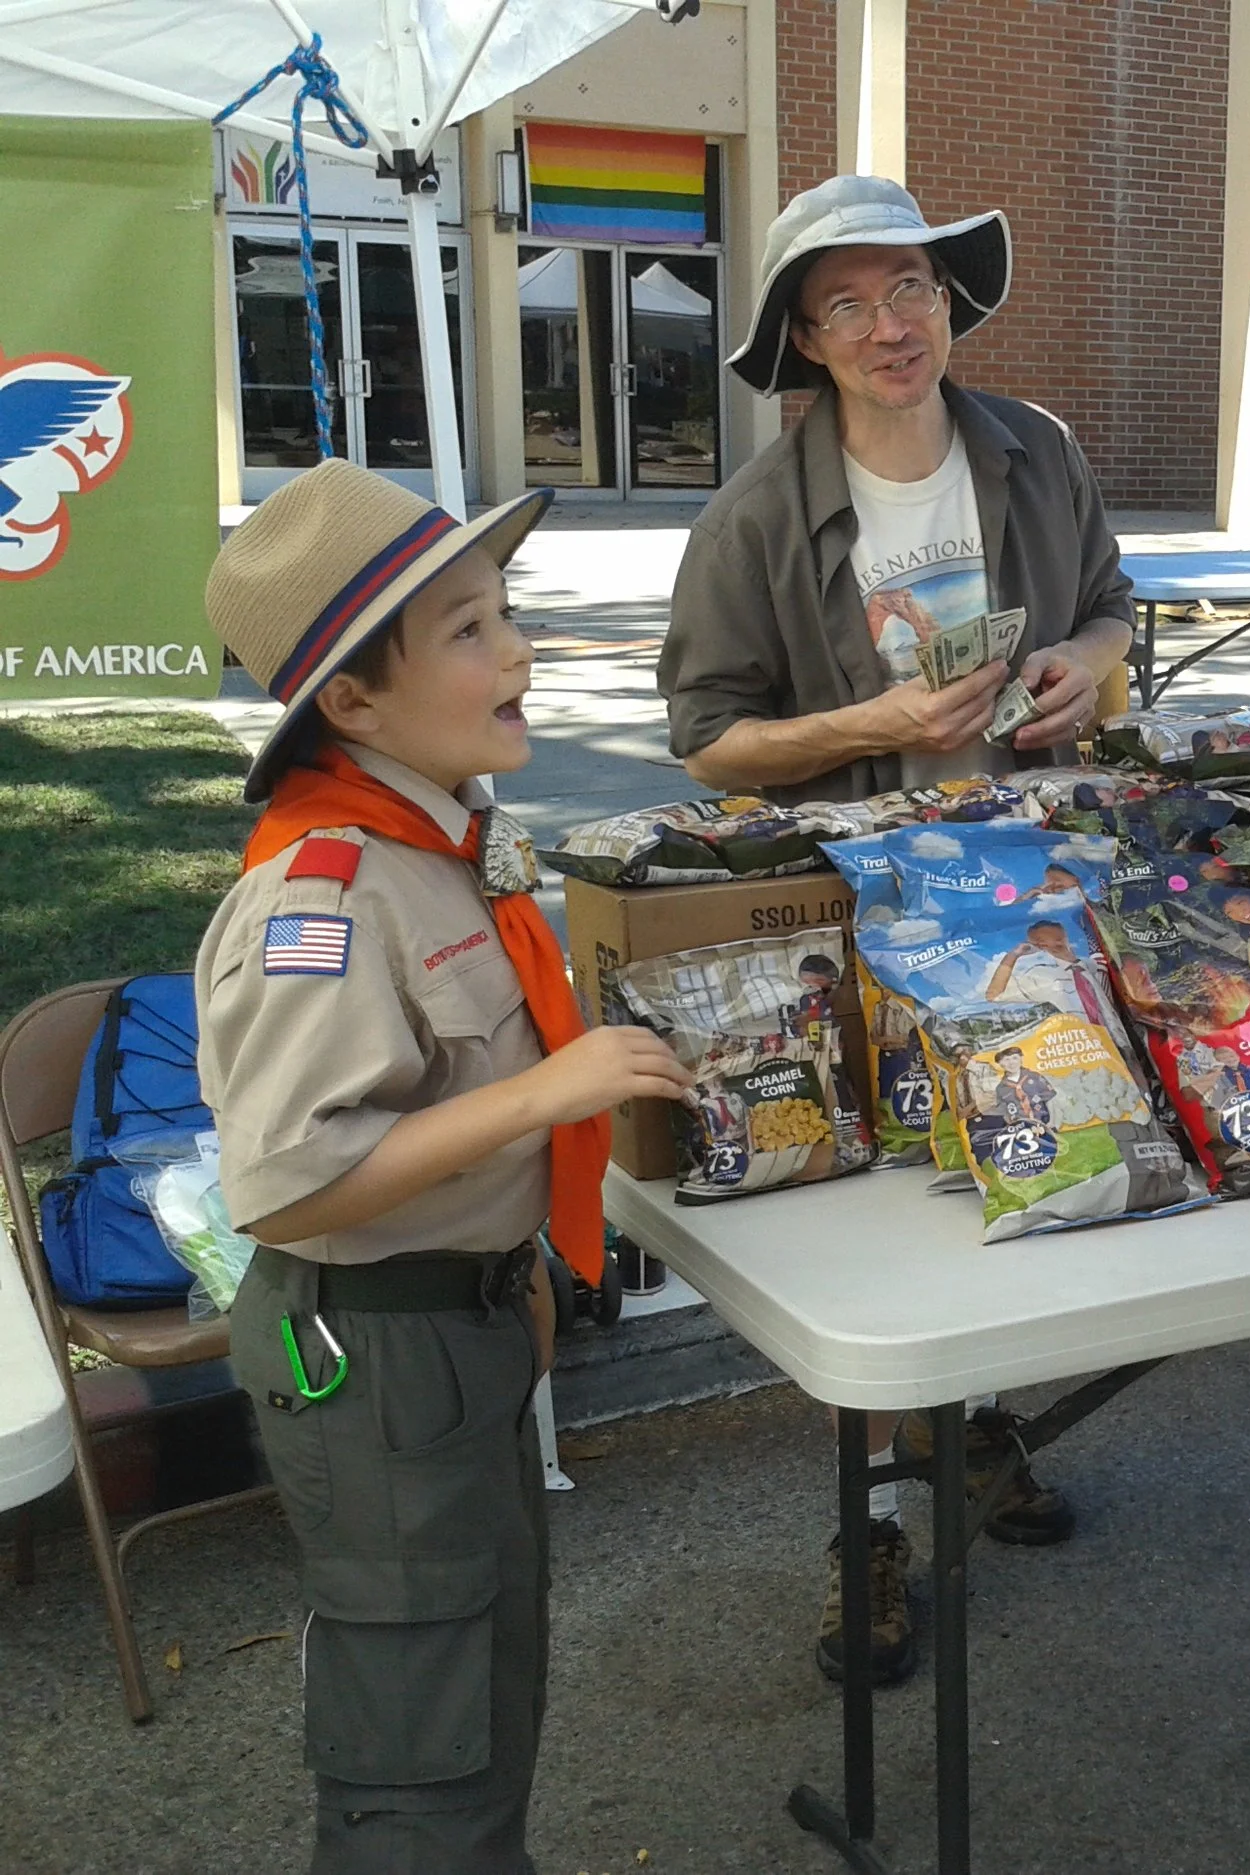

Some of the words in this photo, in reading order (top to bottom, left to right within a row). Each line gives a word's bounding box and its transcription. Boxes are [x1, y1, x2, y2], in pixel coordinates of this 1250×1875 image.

[34, 643, 209, 677] AMERICA
[751, 904, 810, 931] TOSS
[903, 943, 946, 968] Trail's
[1043, 1028, 1089, 1046] WHITE
[1036, 1038, 1105, 1060] CHEDDAR
[1036, 1054, 1078, 1072] CHEESE
[1080, 1050, 1112, 1064] CORN
[744, 1066, 806, 1091] CARAMEL
[760, 1081, 797, 1099] CORN
[996, 1123, 1046, 1160] 73%
[1002, 1155, 1051, 1174] SCOUTING
